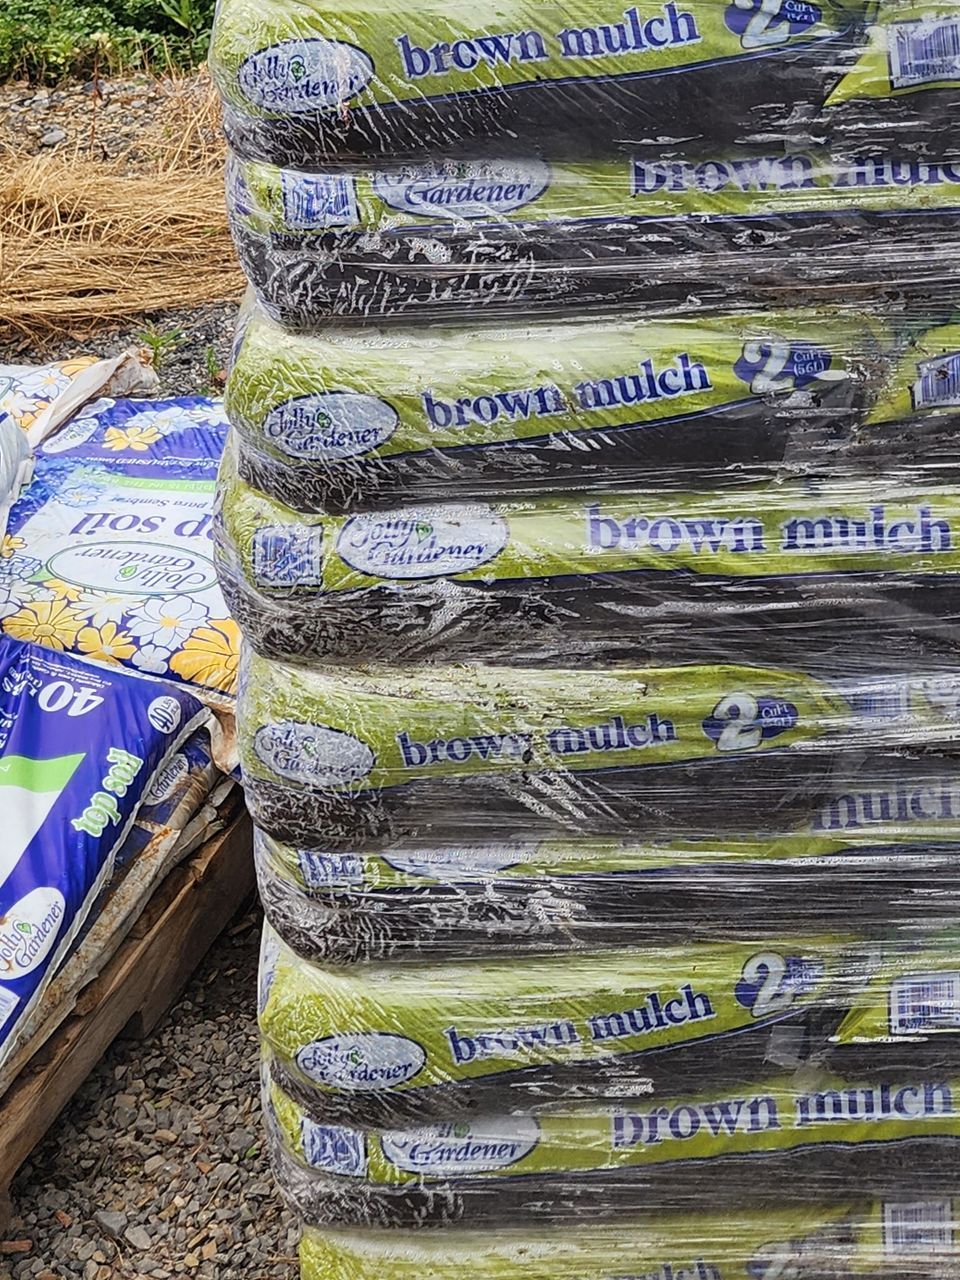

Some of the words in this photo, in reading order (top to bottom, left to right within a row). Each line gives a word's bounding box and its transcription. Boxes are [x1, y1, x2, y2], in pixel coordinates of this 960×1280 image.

[397, 30, 549, 78] brown
[556, 0, 702, 58] mulch
[404, 180, 530, 206] Gardener
[421, 386, 567, 430] brown
[573, 352, 713, 409] mulch
[744, 340, 796, 394] 2
[68, 512, 167, 538] soil
[585, 503, 768, 554] brown
[782, 502, 955, 552] mulch
[74, 547, 196, 573] Gardener
[136, 566, 207, 591] Jolly
[37, 680, 105, 717] 40
[148, 707, 174, 734] 40
[712, 691, 763, 752] 2
[546, 712, 679, 754] mulch
[71, 791, 122, 838] top
[102, 746, 145, 798] soil
[14, 900, 64, 968] Gardener
[743, 950, 796, 1019] 2
[588, 983, 716, 1041] mulch
[795, 1079, 956, 1128] mulch
[409, 1138, 521, 1166] Gardener
